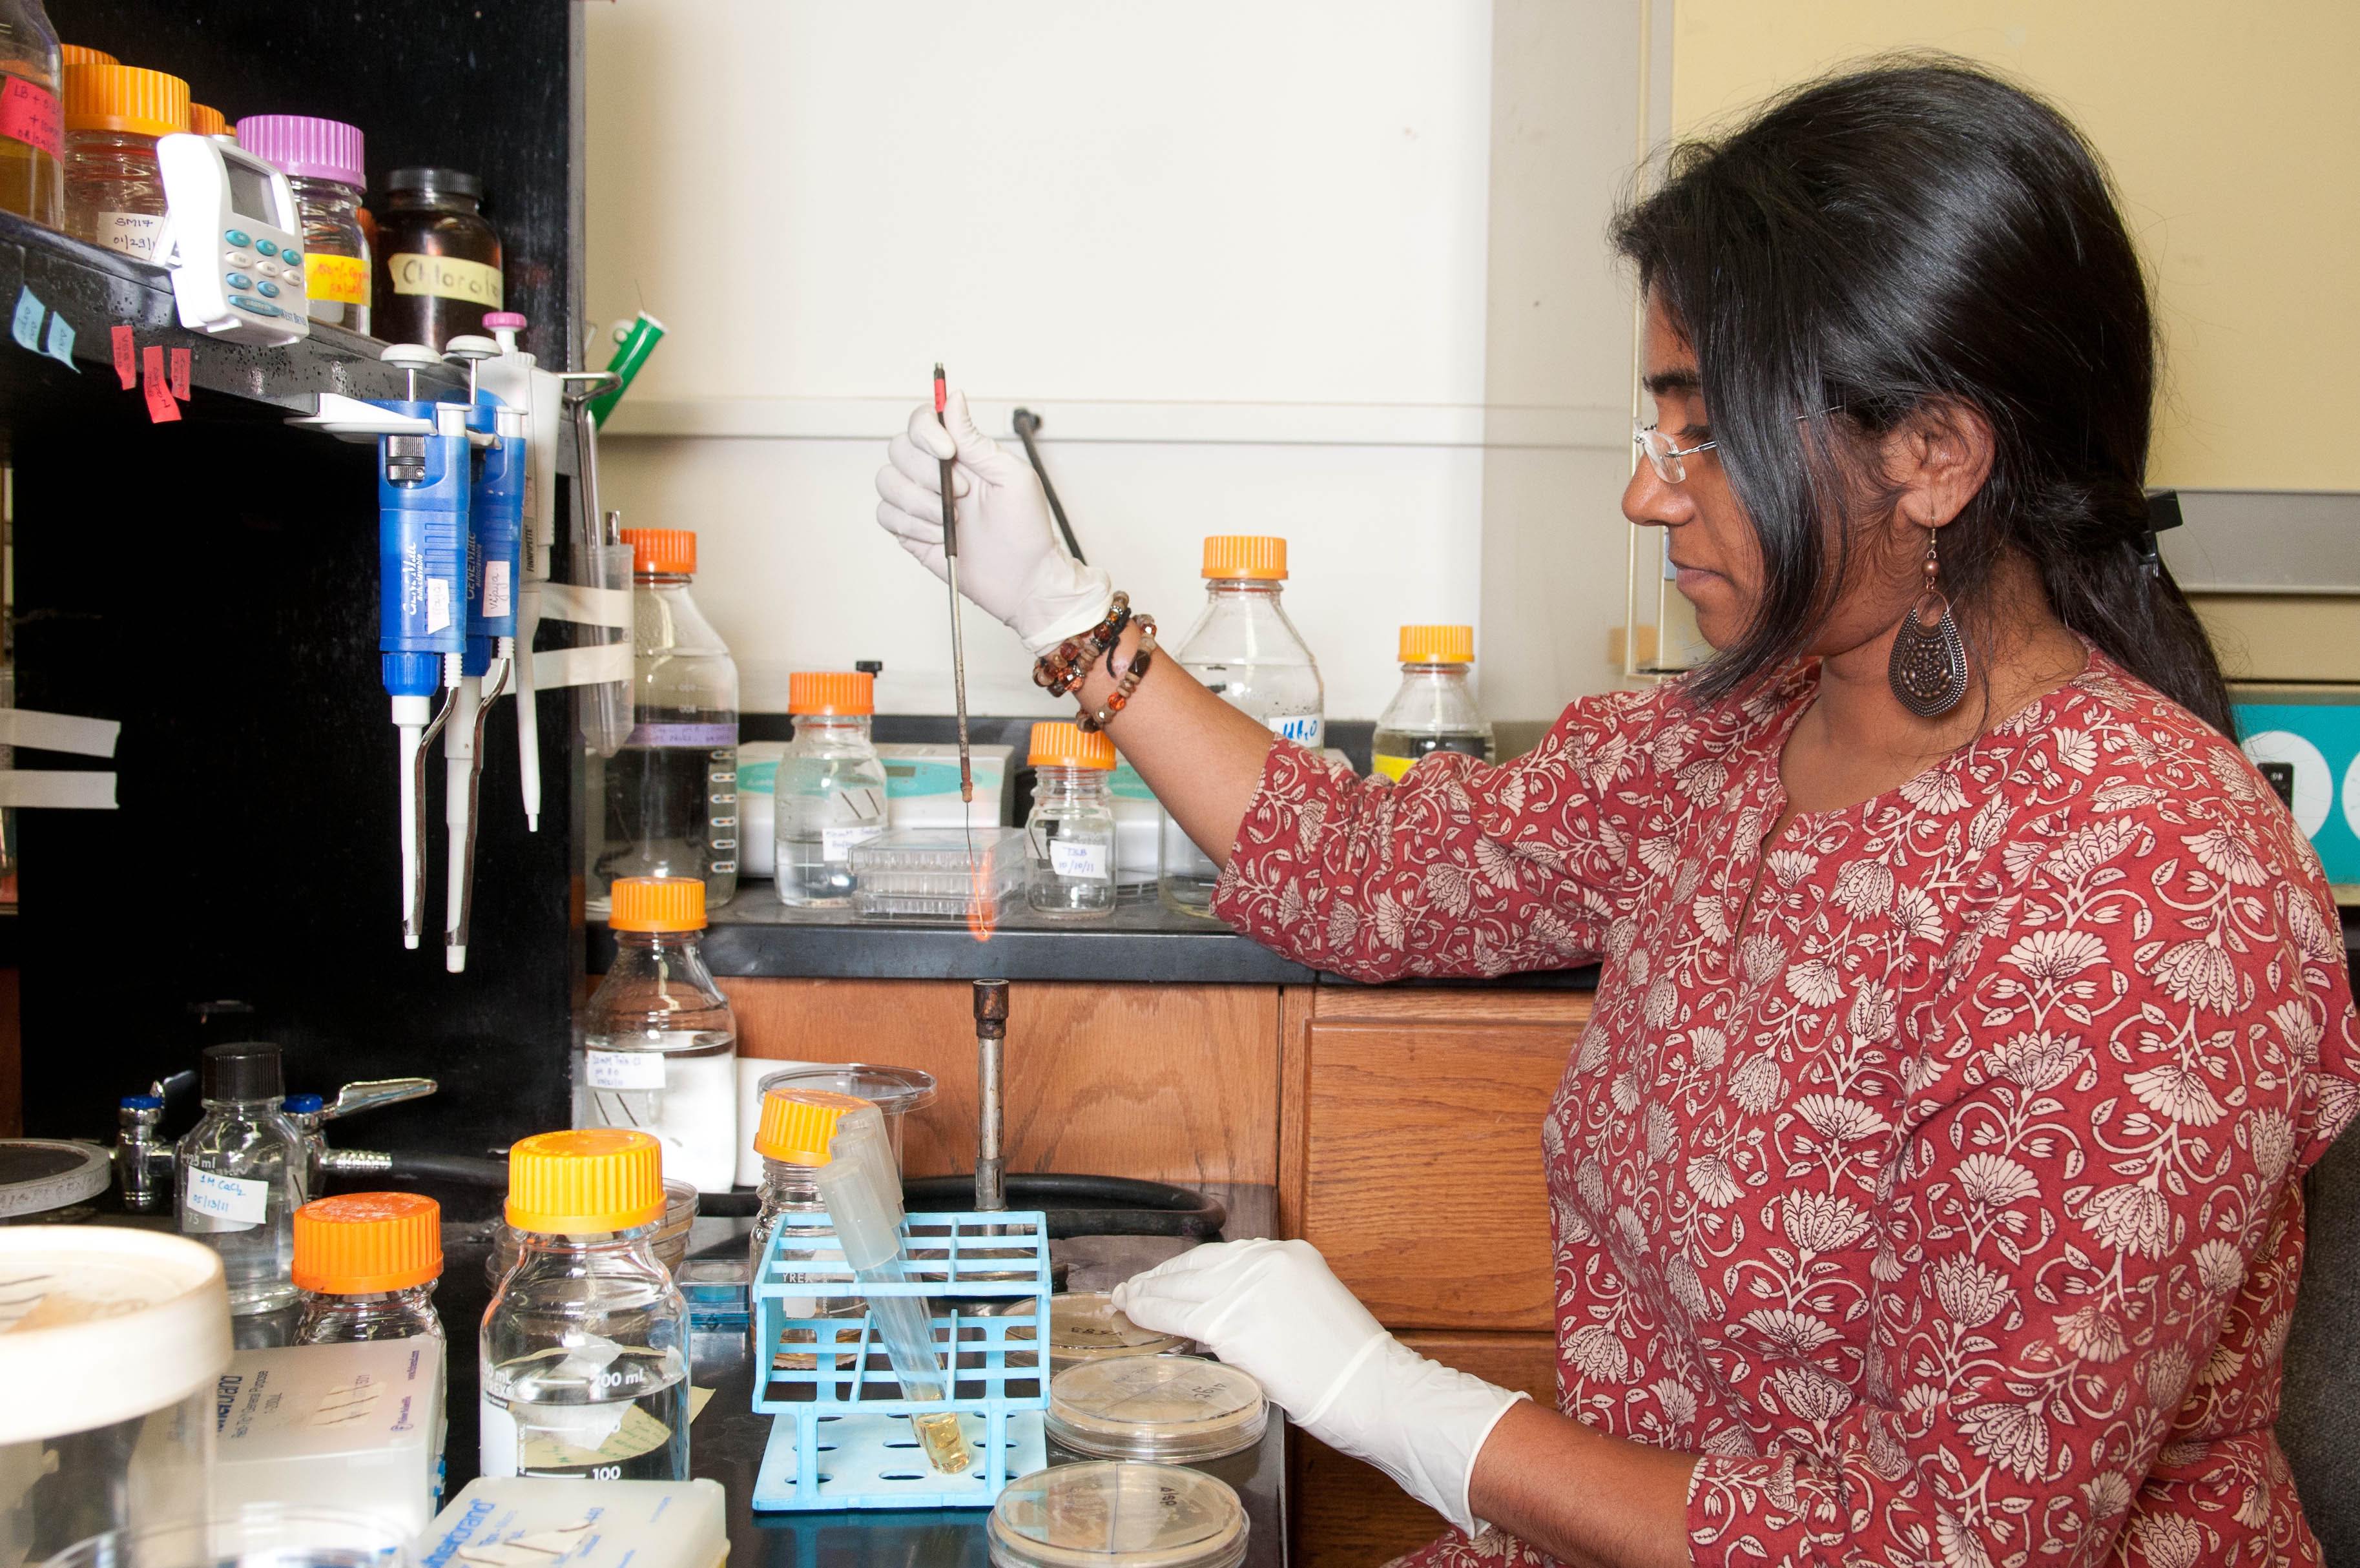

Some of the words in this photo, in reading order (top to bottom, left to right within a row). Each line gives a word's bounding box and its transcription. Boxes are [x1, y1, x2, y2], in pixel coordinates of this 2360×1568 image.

[14, 83, 28, 99] LB
[526, 525, 535, 572] FINNPIPETTE
[188, 1212, 200, 1225] 75
[782, 1272, 814, 1283] YREX
[592, 1465, 621, 1481] 100
